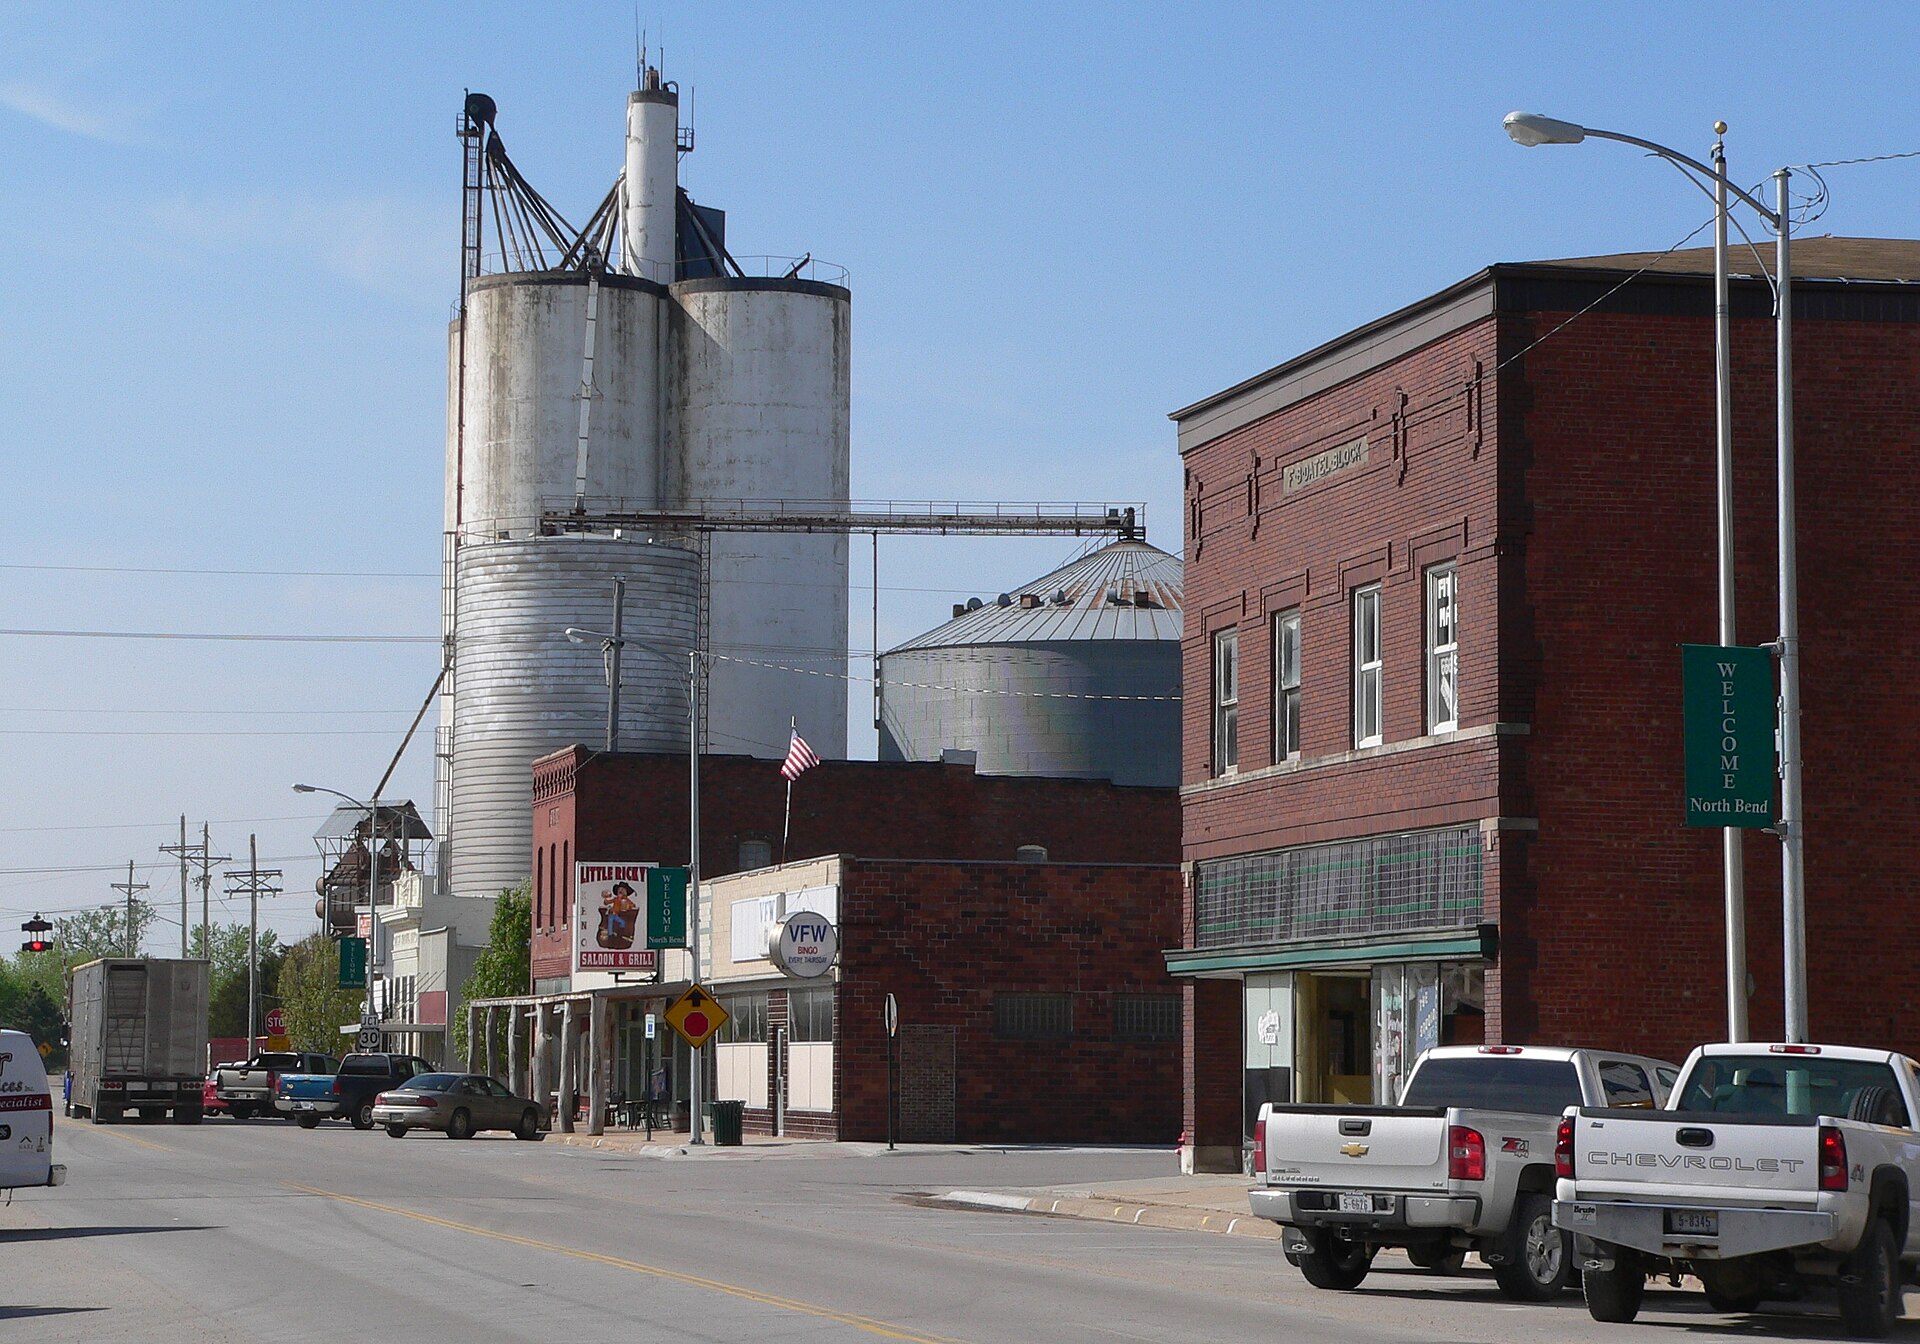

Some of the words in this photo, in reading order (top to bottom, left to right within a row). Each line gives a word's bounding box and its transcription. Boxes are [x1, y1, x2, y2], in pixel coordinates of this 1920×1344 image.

[1716, 662, 1739, 789] WELCOME
[1690, 797, 1731, 813] North
[1735, 799, 1768, 814] Bend
[580, 866, 613, 884] LITTLE
[662, 875, 671, 933] WELCOME
[789, 925, 827, 942] VFW
[649, 936, 668, 944] North
[669, 936, 685, 944] Bend
[798, 946, 818, 955] BINGO
[582, 953, 615, 965] SALOON
[619, 953, 624, 965] &
[629, 953, 653, 965] GRILL
[267, 1017, 285, 1028] STO
[362, 1017, 378, 1026] JCT
[361, 1032, 378, 1044] 30
[1588, 1151, 1804, 1173] CHEVROLET
[1573, 1205, 1596, 1214] Brute
[1678, 1214, 1711, 1227] 5-8345
